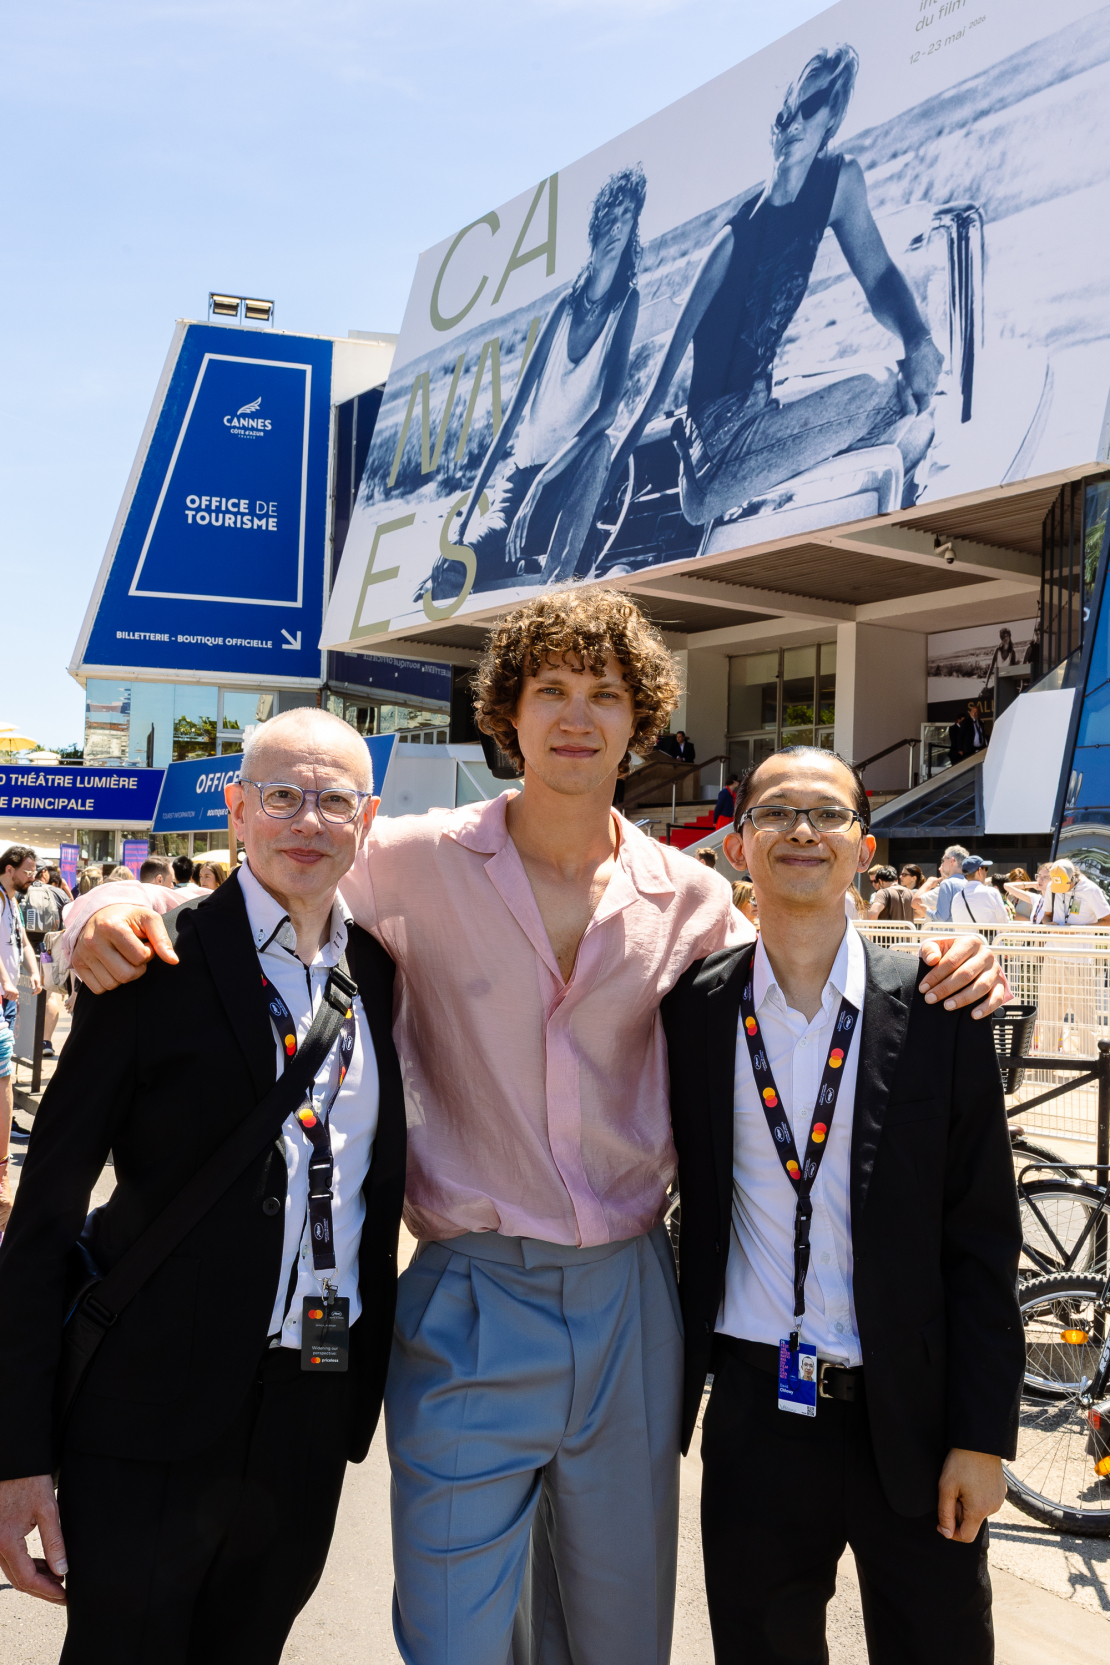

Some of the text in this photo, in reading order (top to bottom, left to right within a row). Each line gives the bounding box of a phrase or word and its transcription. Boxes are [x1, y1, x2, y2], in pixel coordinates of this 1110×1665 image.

[915, 0, 966, 32] du film
[944, 26, 967, 47] mai
[968, 14, 987, 29] 2026
[223, 415, 272, 430] CANNES
[185, 494, 278, 516] OFFICE DE
[185, 510, 278, 531] TOURISME
[116, 630, 170, 642] BILLETTERIE
[177, 634, 224, 646] BOUTIQUE
[225, 637, 273, 649] OFFICIELLE
[9, 772, 73, 787] THÉÂTRE
[76, 774, 138, 789] LUMIÈRE
[11, 797, 95, 811] PRINCIPALE
[27, 910, 35, 930] PUMA
